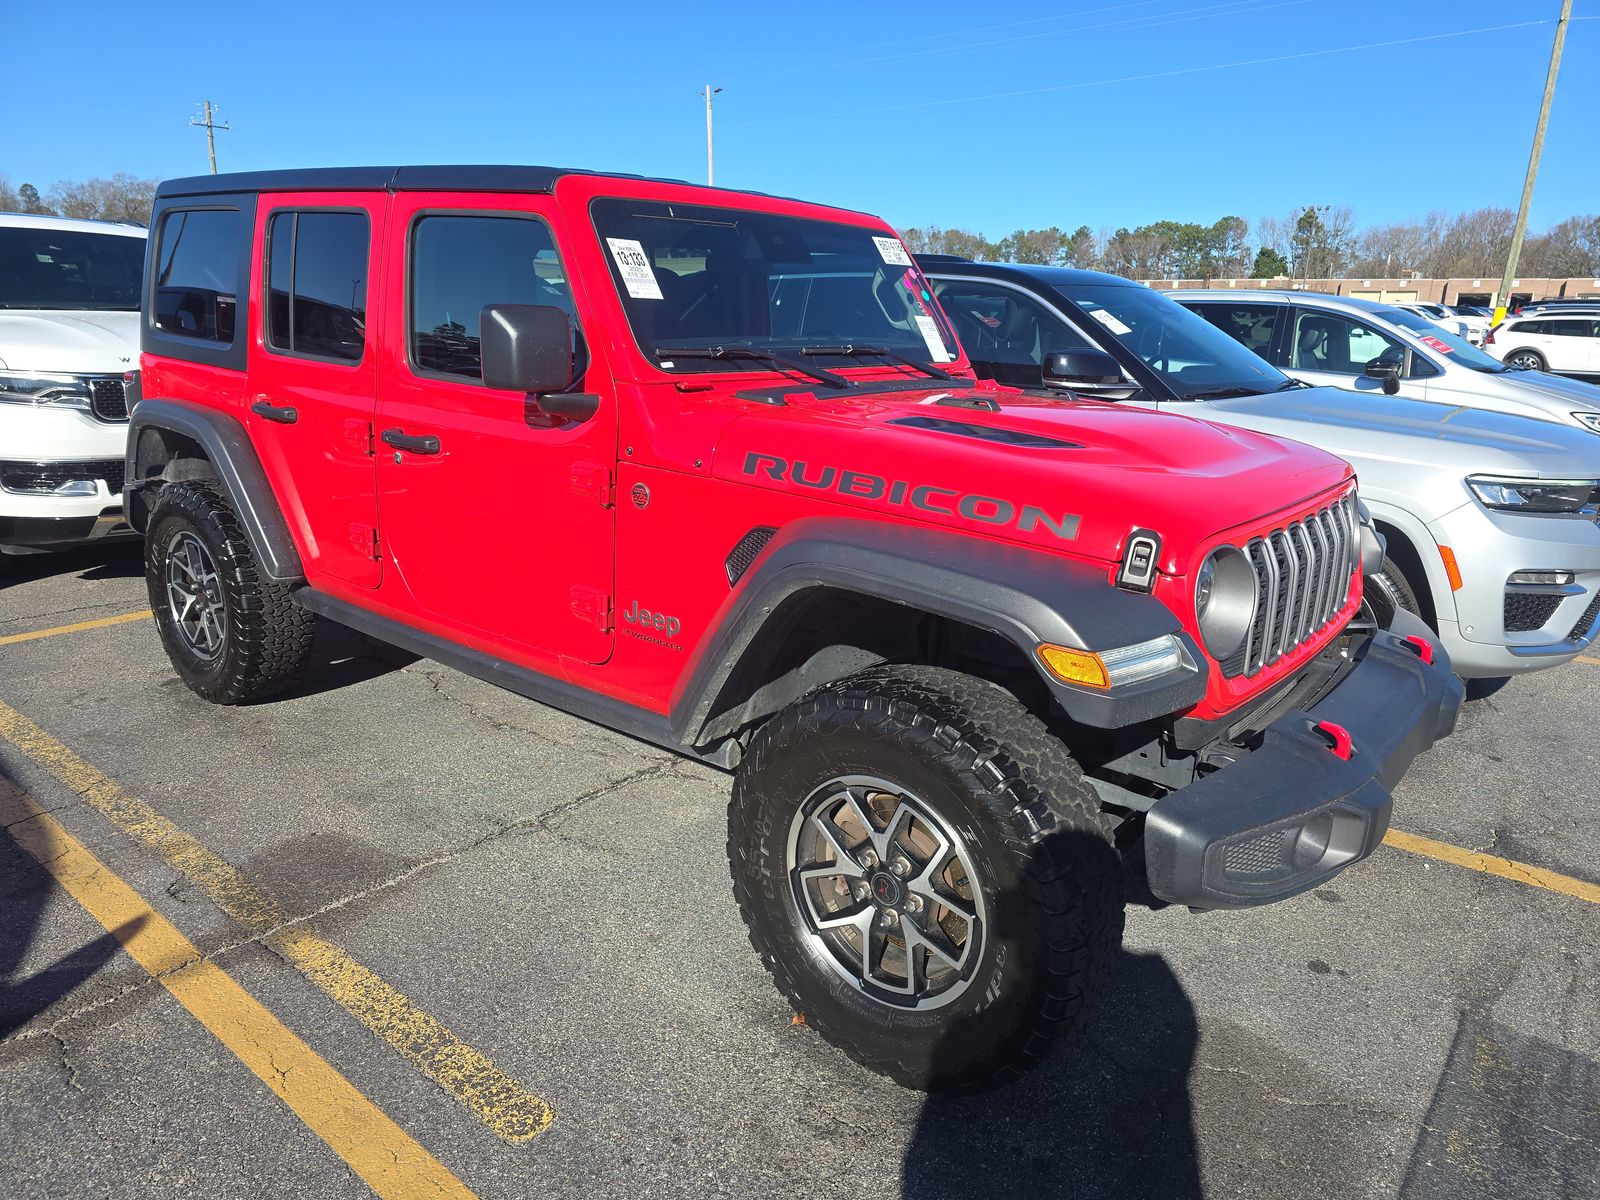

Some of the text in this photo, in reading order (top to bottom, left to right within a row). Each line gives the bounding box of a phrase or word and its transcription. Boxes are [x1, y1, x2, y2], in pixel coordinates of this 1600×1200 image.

[616, 251, 646, 267] 13:133
[743, 451, 1082, 541] RUBICON
[623, 599, 681, 638] Jeep
[631, 630, 683, 652] WRANGLER
